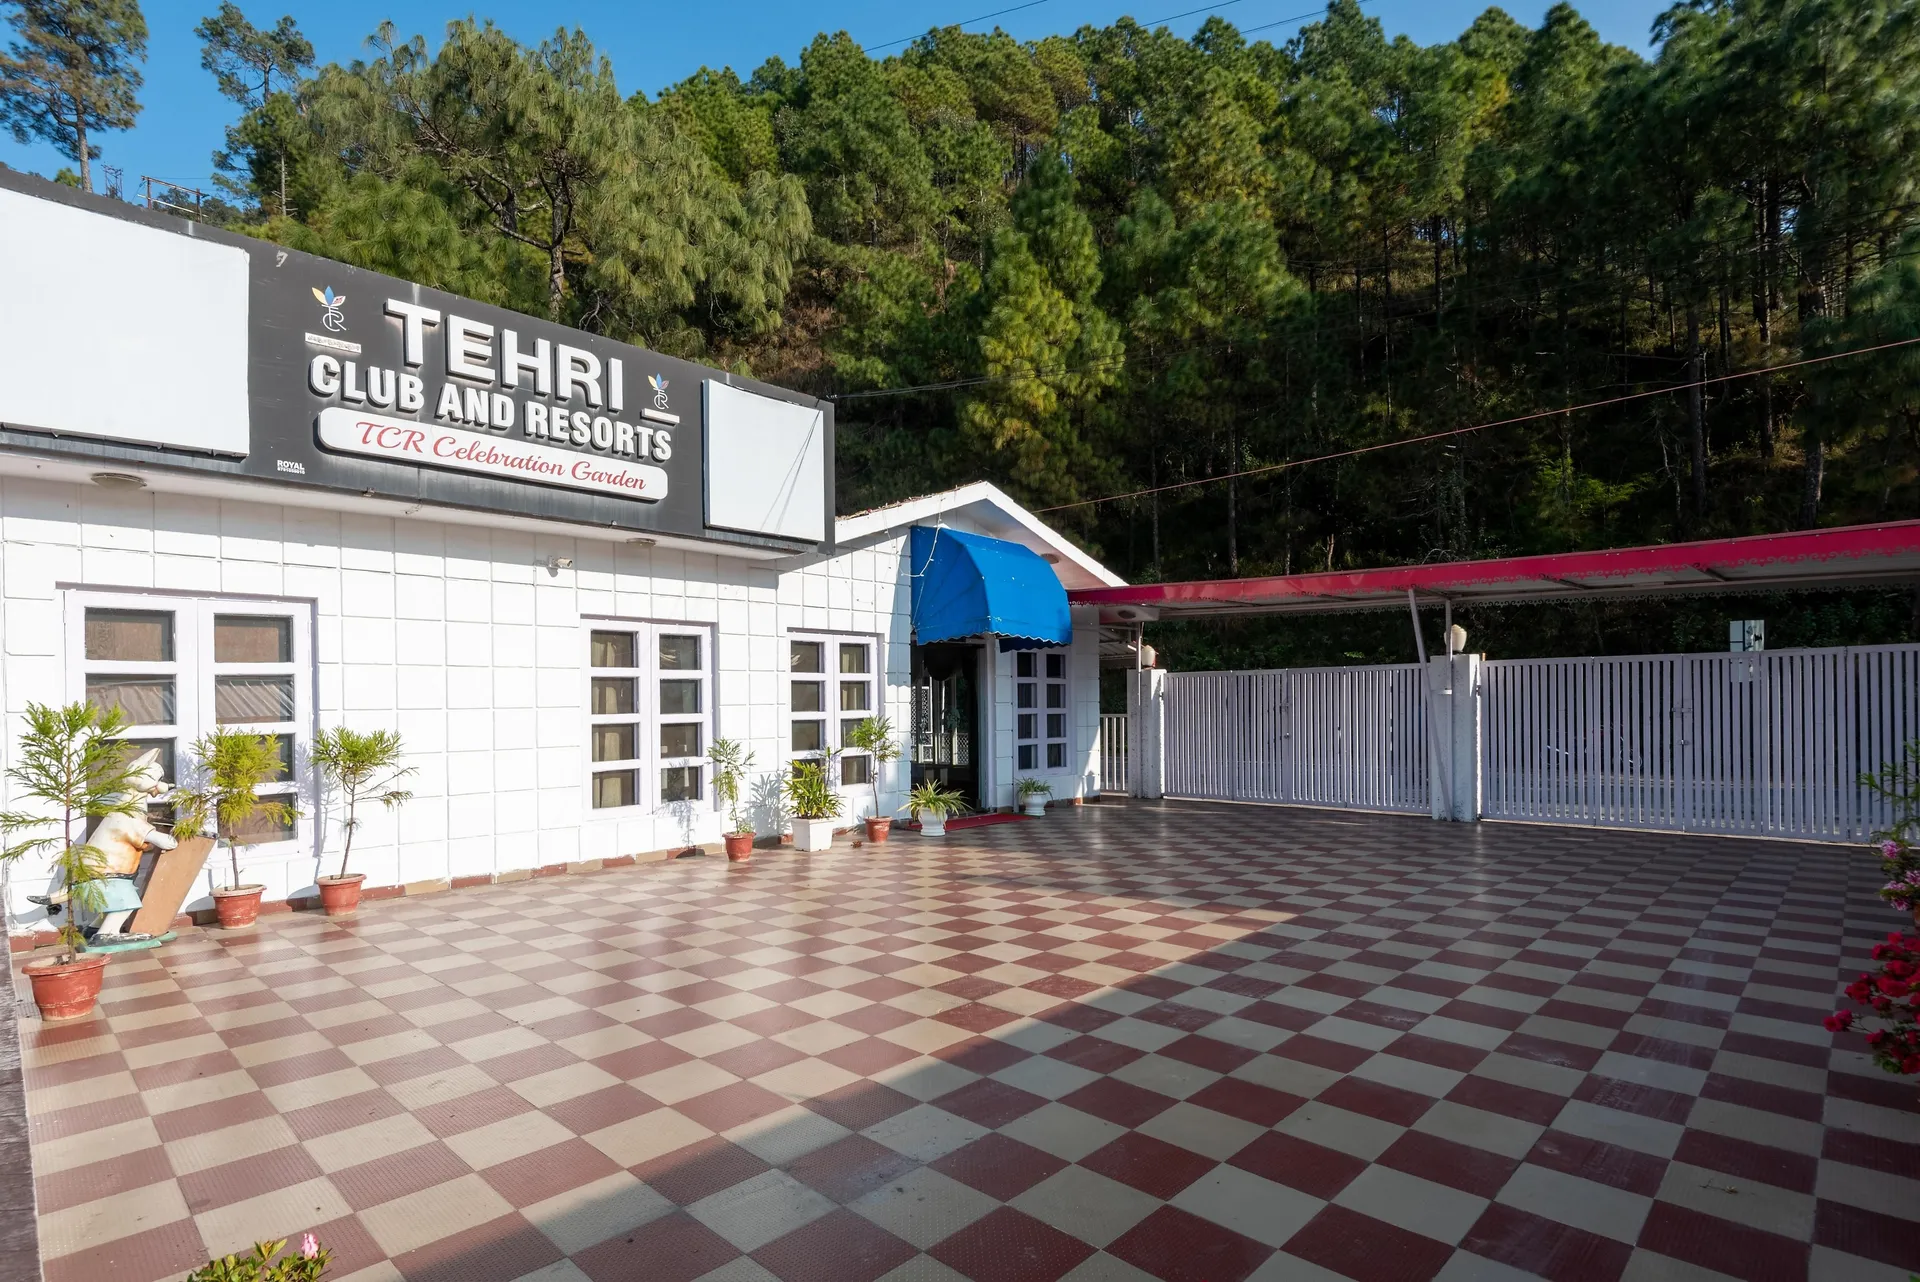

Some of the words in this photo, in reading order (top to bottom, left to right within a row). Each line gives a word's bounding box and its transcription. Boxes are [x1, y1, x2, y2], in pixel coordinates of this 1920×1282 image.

[385, 298, 624, 411] TEHRI
[310, 354, 425, 411] CLUB
[436, 383, 515, 429] AND
[526, 400, 672, 461] RESORTS
[277, 460, 305, 471] ROYAL
[356, 421, 425, 453] TCR
[432, 436, 566, 476] Celebration
[571, 460, 647, 490] Garden
